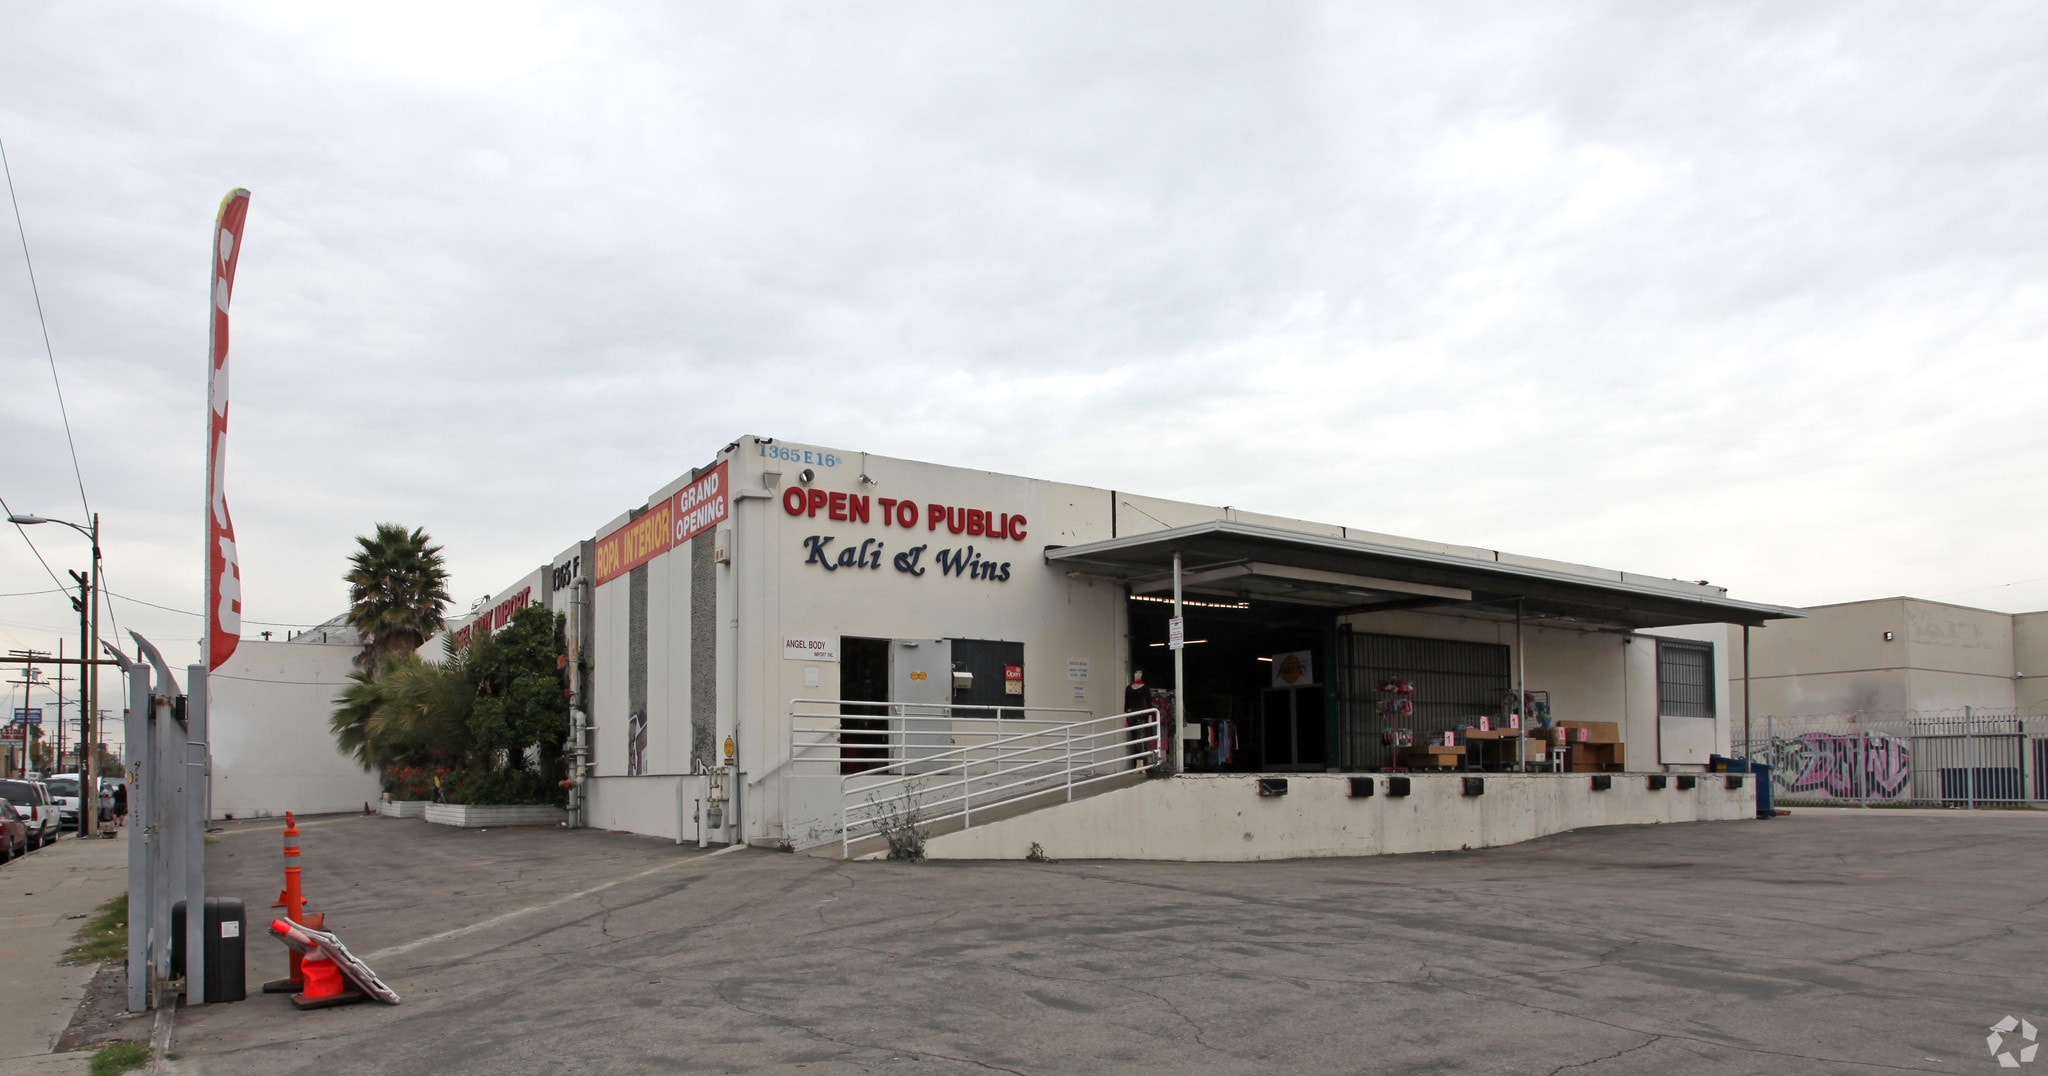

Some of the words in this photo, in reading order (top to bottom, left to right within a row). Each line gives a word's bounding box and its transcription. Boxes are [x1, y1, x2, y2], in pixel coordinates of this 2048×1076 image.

[759, 444, 800, 463] 1365
[680, 472, 719, 513] GRAND
[783, 486, 870, 524] OPEN
[878, 497, 919, 528] TO
[928, 503, 1028, 541] PUBLIC
[676, 495, 724, 541] OPENING
[597, 538, 620, 579] ROPA
[623, 507, 670, 565] INTERIOR
[803, 535, 884, 571] Kali
[893, 543, 928, 577] &
[935, 545, 1012, 581] Wins
[552, 559, 571, 592] 1365
[494, 585, 531, 631] IMPORT
[785, 639, 807, 648] ANGEL
[808, 640, 826, 649] BODY
[1005, 670, 1021, 678] Open
